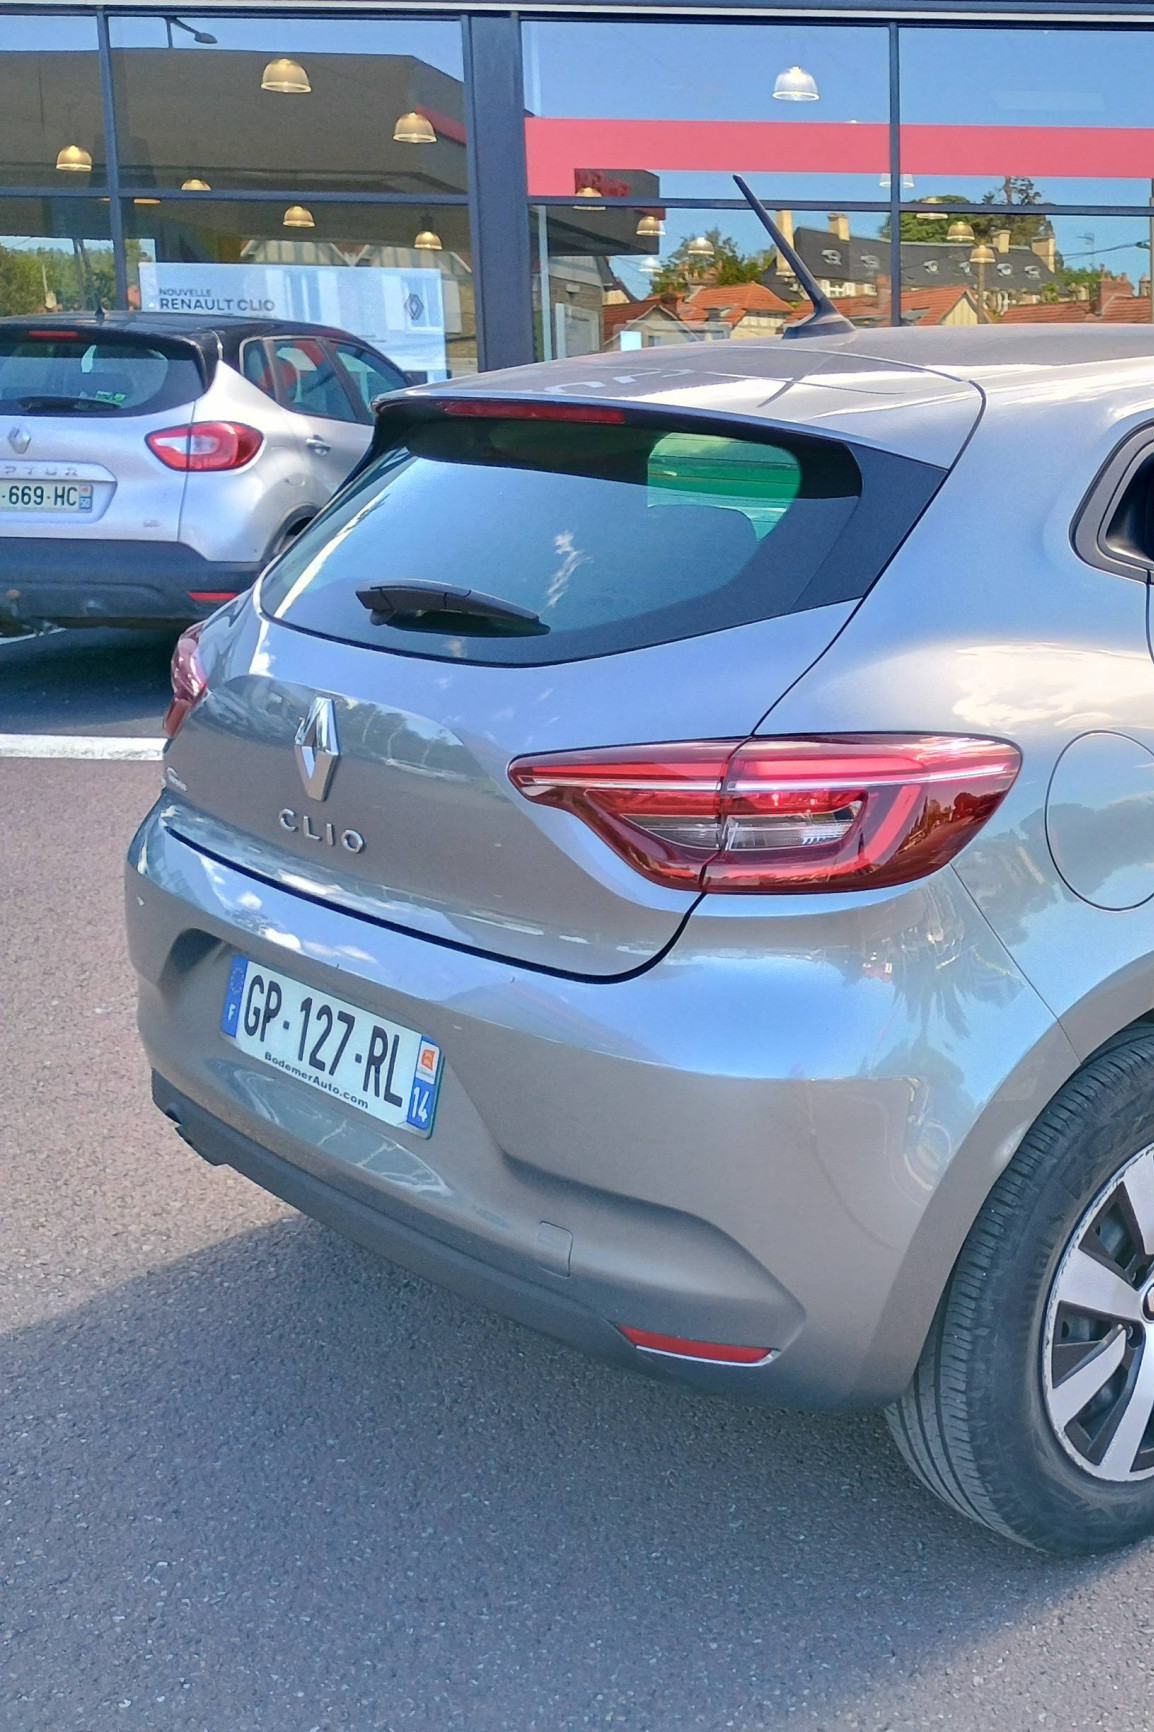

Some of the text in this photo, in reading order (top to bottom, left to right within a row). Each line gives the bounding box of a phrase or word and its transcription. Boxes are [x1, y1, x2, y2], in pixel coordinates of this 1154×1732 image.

[159, 288, 212, 297] NOUVELLE
[160, 298, 275, 311] RENAULT CLIO
[279, 808, 365, 853] CLIO
[227, 1003, 236, 1021] F
[243, 974, 403, 1108] GP-127-RL
[264, 1051, 369, 1110] BodemerAuto.com
[411, 1086, 430, 1123] 14
